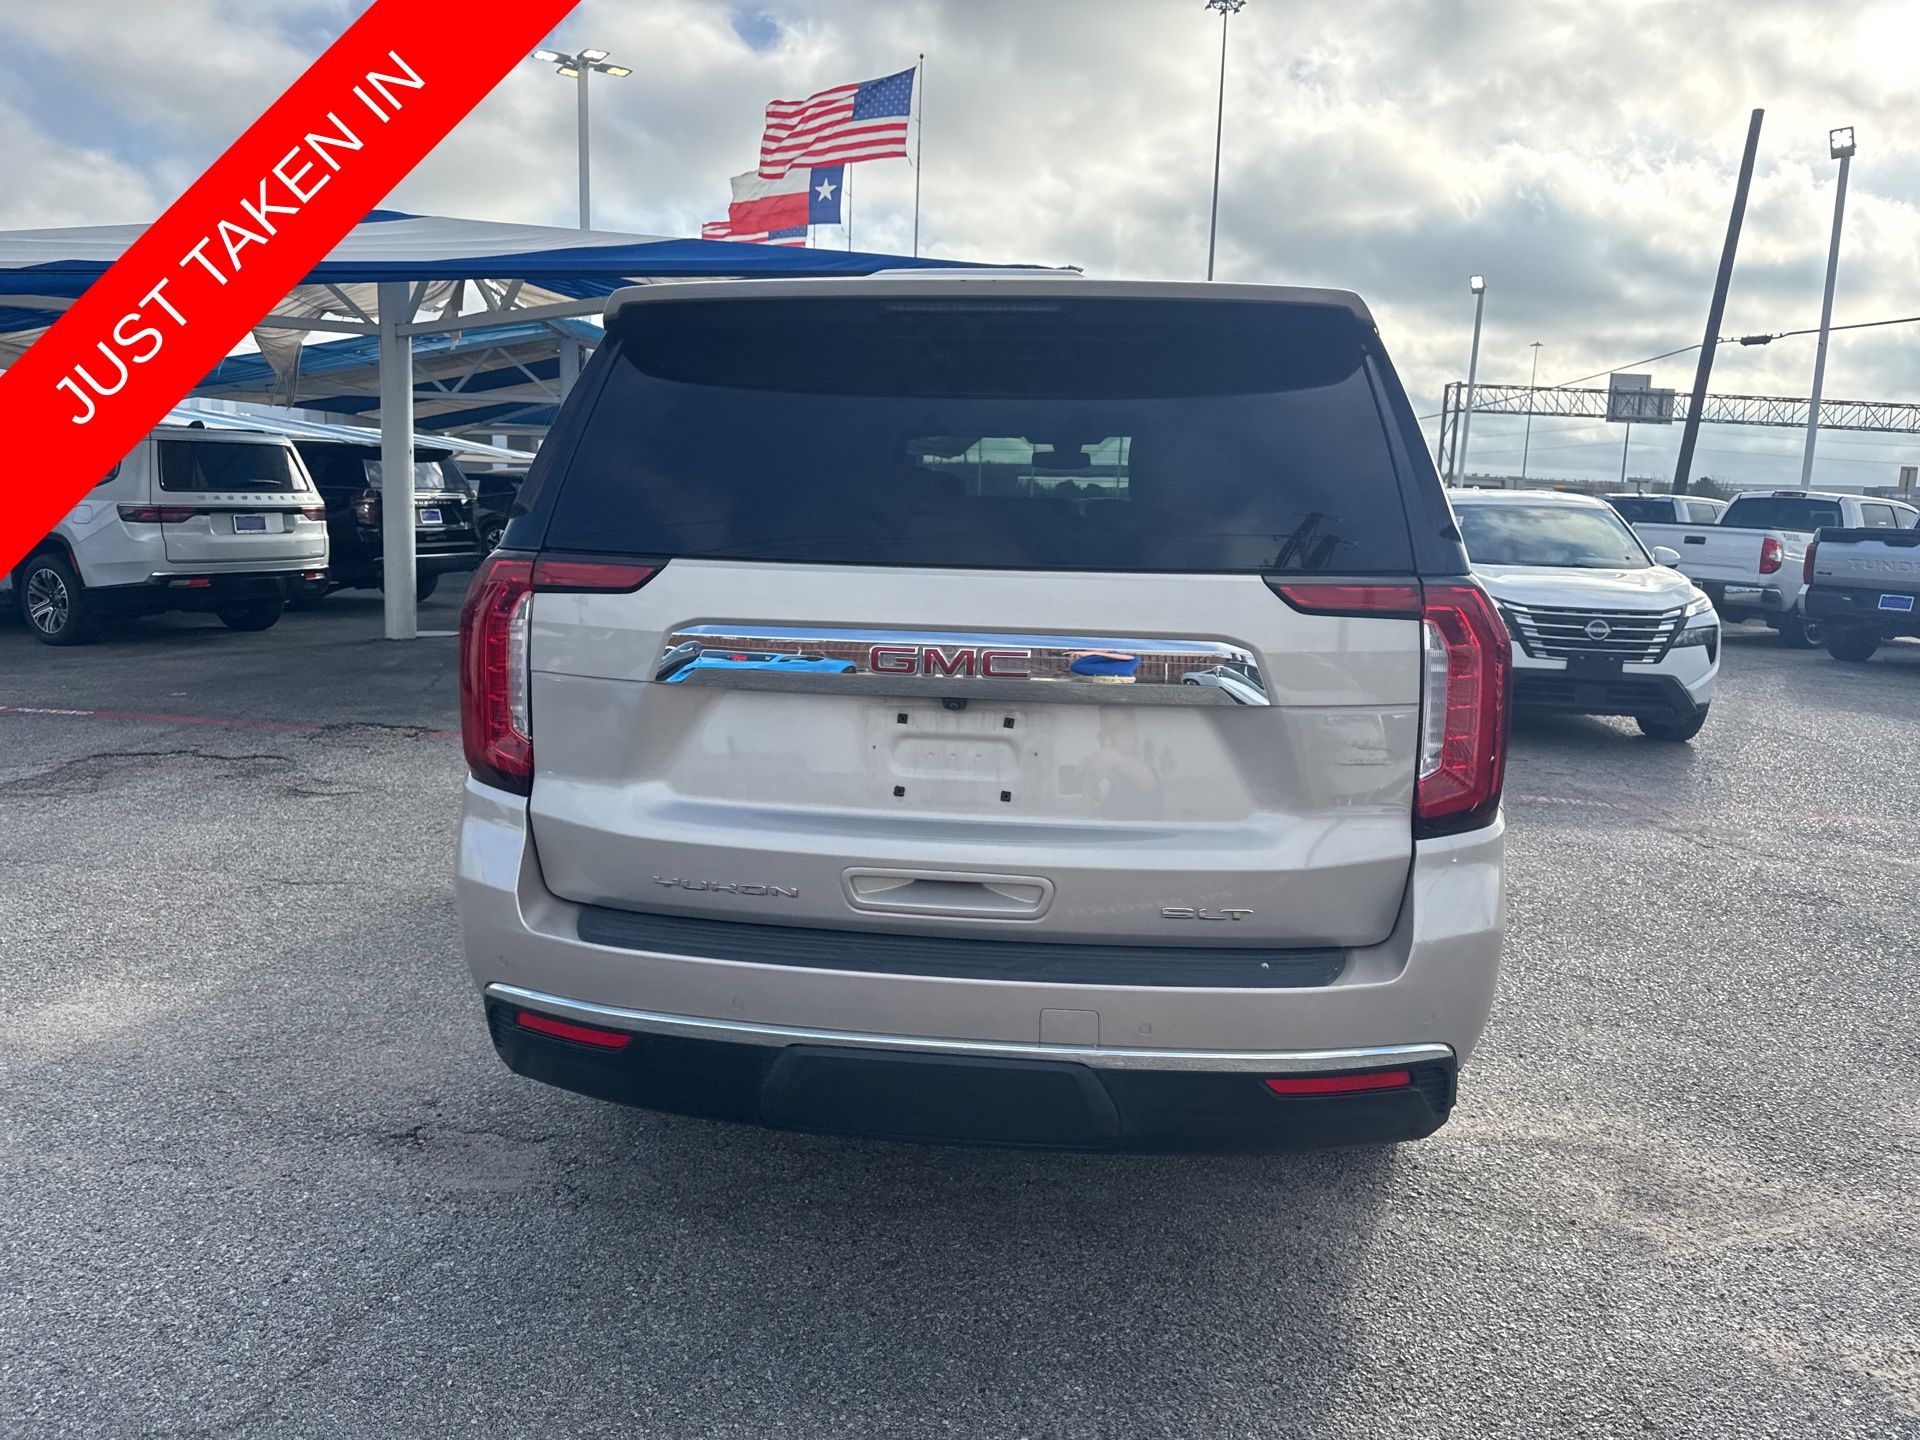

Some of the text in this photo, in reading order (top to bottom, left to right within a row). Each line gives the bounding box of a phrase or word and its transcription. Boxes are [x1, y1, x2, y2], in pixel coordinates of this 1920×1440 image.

[869, 645, 1031, 679] GMC
[653, 875, 799, 898] YUKON
[1161, 907, 1254, 921] SLT
